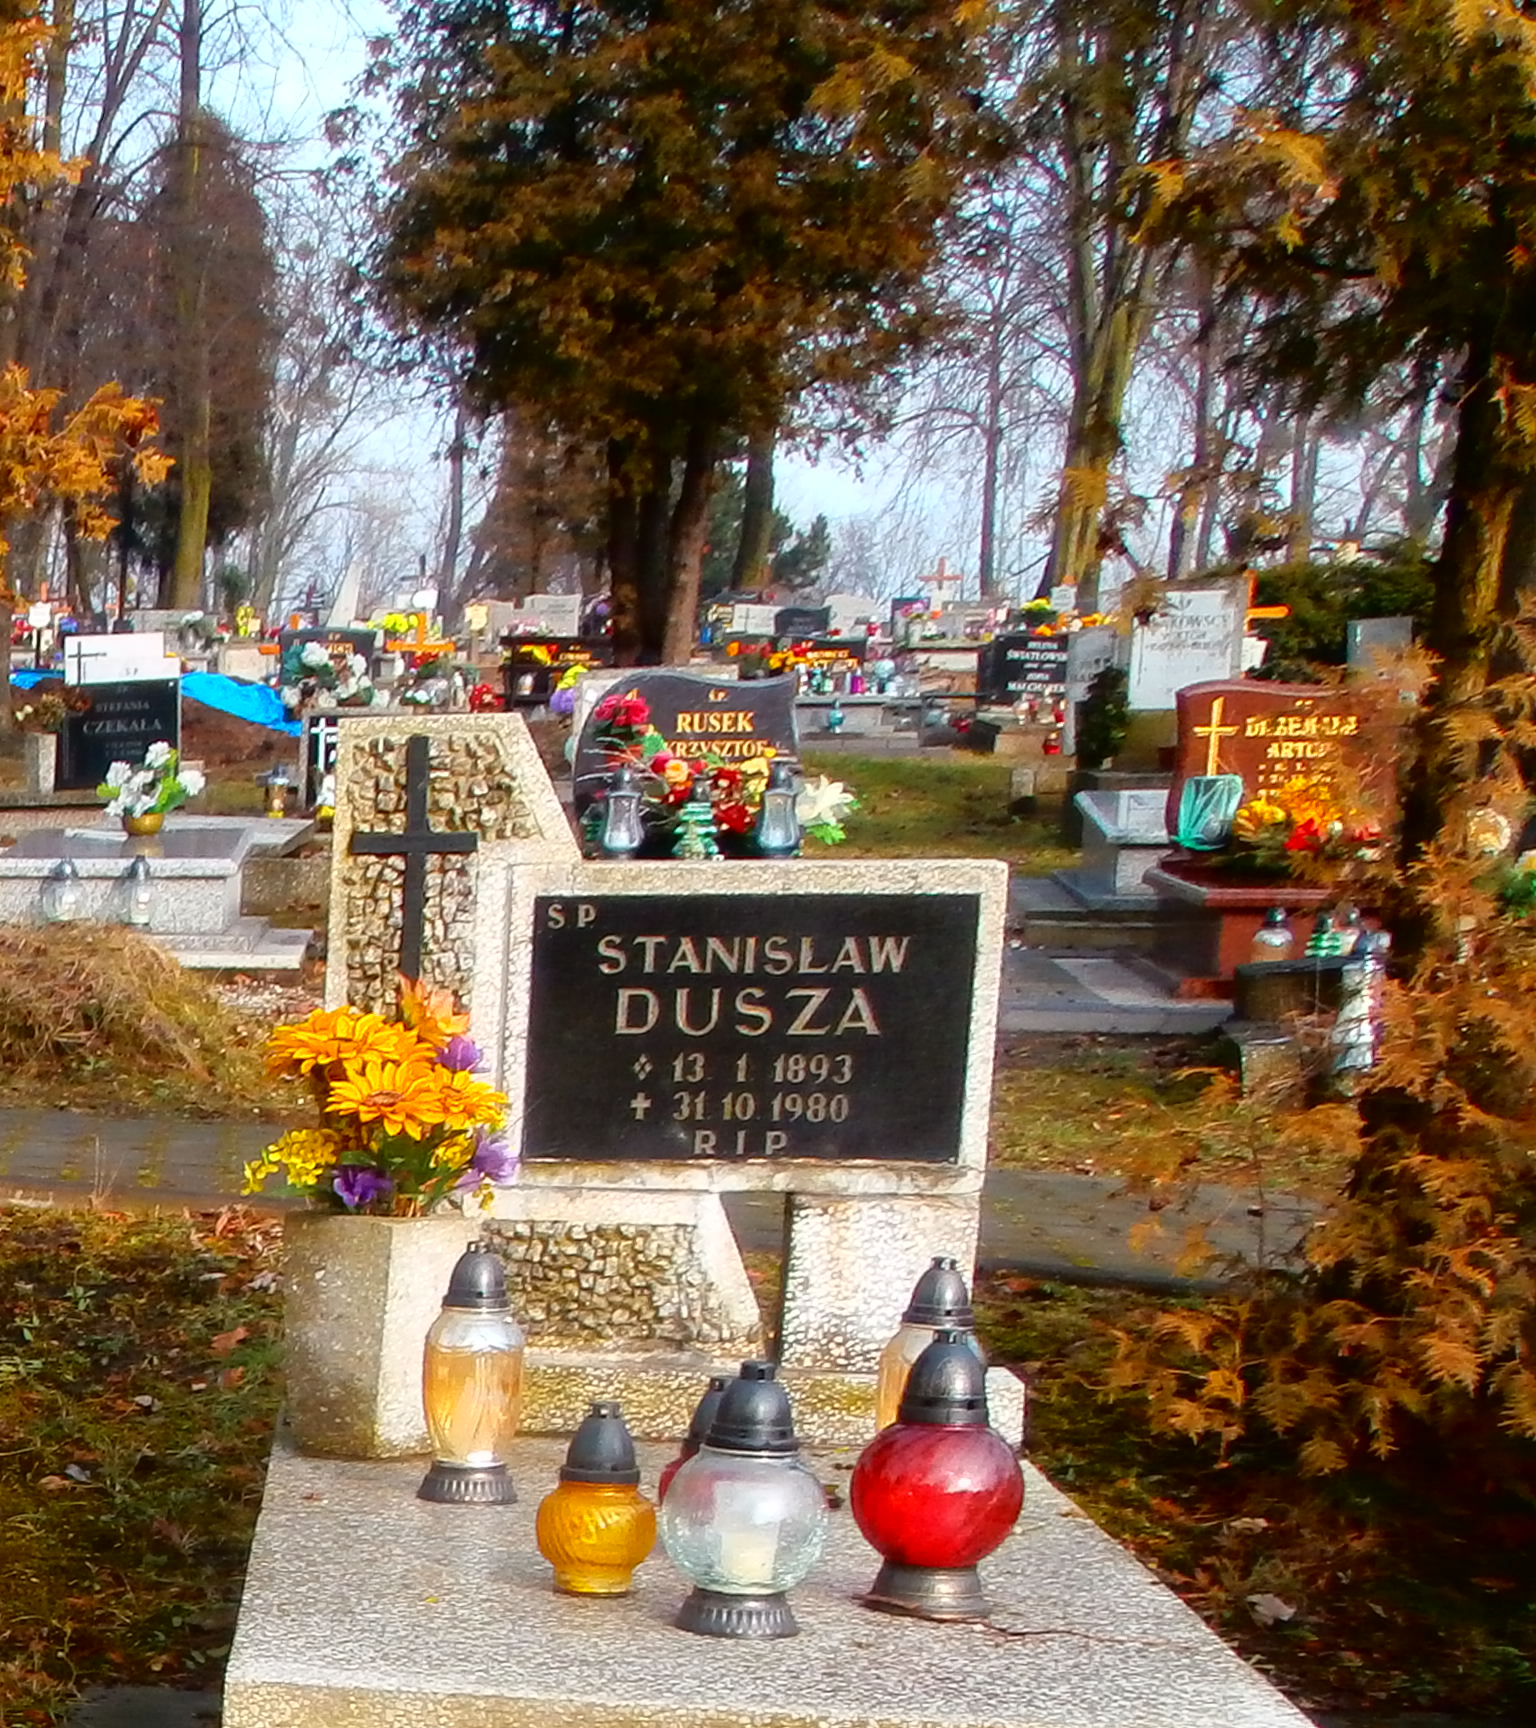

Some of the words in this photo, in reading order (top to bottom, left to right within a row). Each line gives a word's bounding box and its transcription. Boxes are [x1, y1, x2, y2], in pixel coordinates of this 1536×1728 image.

[676, 711, 755, 733] RUSEK
[664, 738, 769, 758] KRZYSZTOF
[614, 985, 882, 1037] DUSZA
